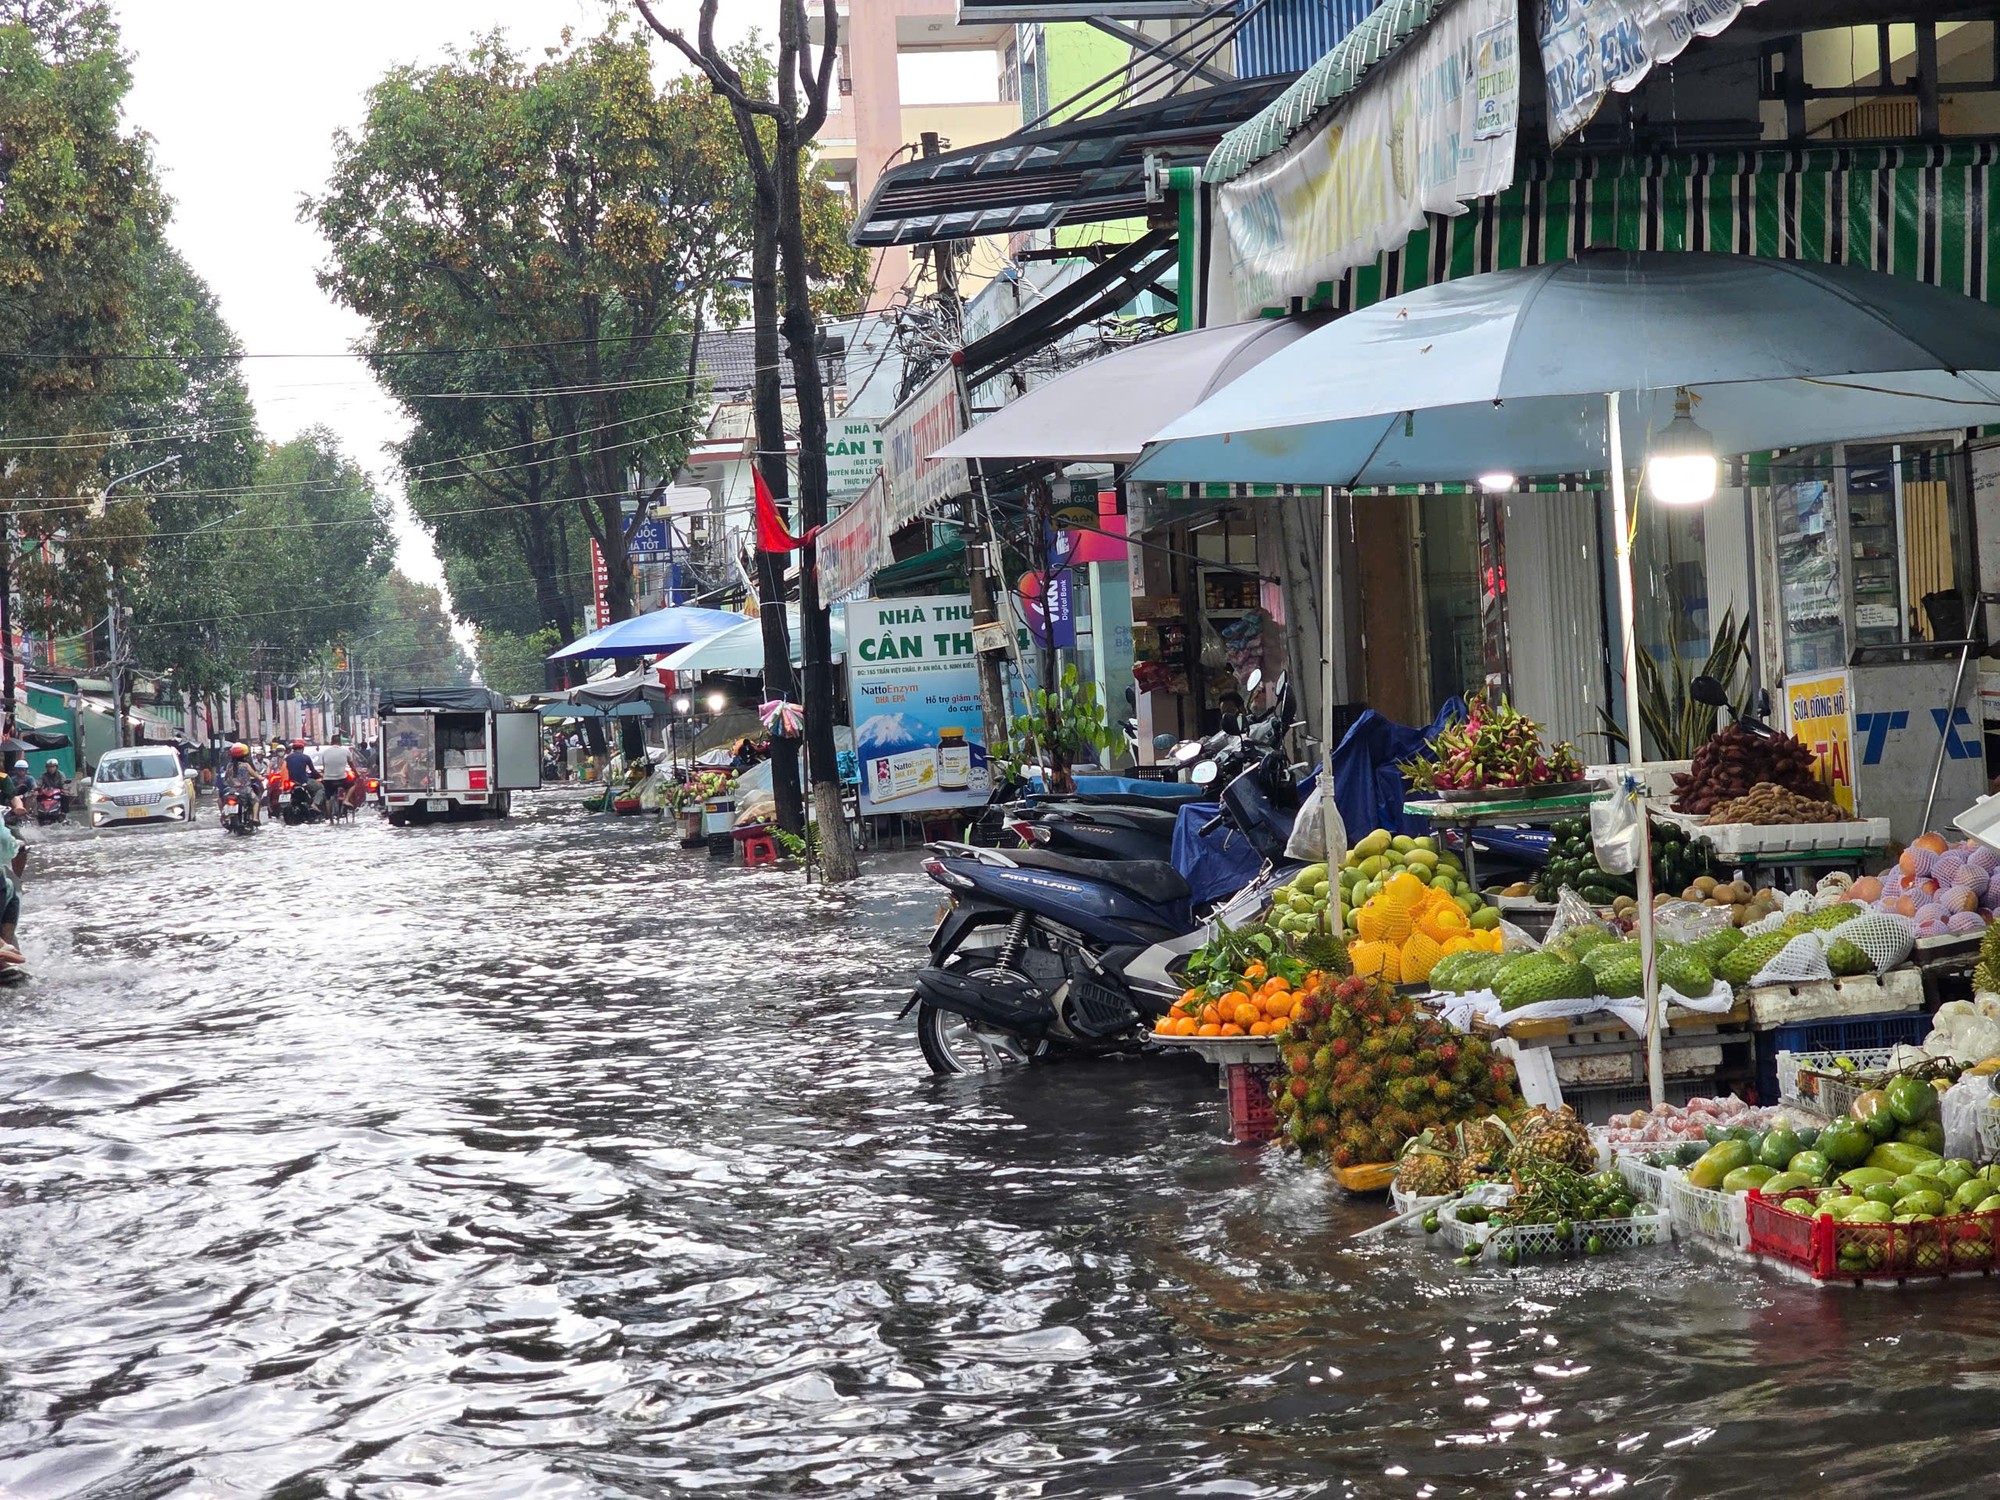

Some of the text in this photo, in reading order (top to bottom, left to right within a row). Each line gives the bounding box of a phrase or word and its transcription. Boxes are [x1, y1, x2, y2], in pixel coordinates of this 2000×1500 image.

[1600, 17, 1647, 83] EM
[844, 422, 870, 435] NHÀ
[826, 437, 866, 457] CẦN
[828, 468, 850, 477] HUYÊN
[641, 537, 659, 549] TỐT
[879, 605, 974, 626] NHÀ THU
[1060, 597, 1069, 621] Digital
[858, 629, 923, 662] CẦN
[934, 632, 974, 656] TH
[861, 683, 919, 696] NattoEnzym
[892, 695, 906, 704] EPA
[1810, 689, 1832, 718] ĐỒNG
[1833, 685, 1845, 714] HỒ
[1000, 873, 1083, 892] AIR BLADE
